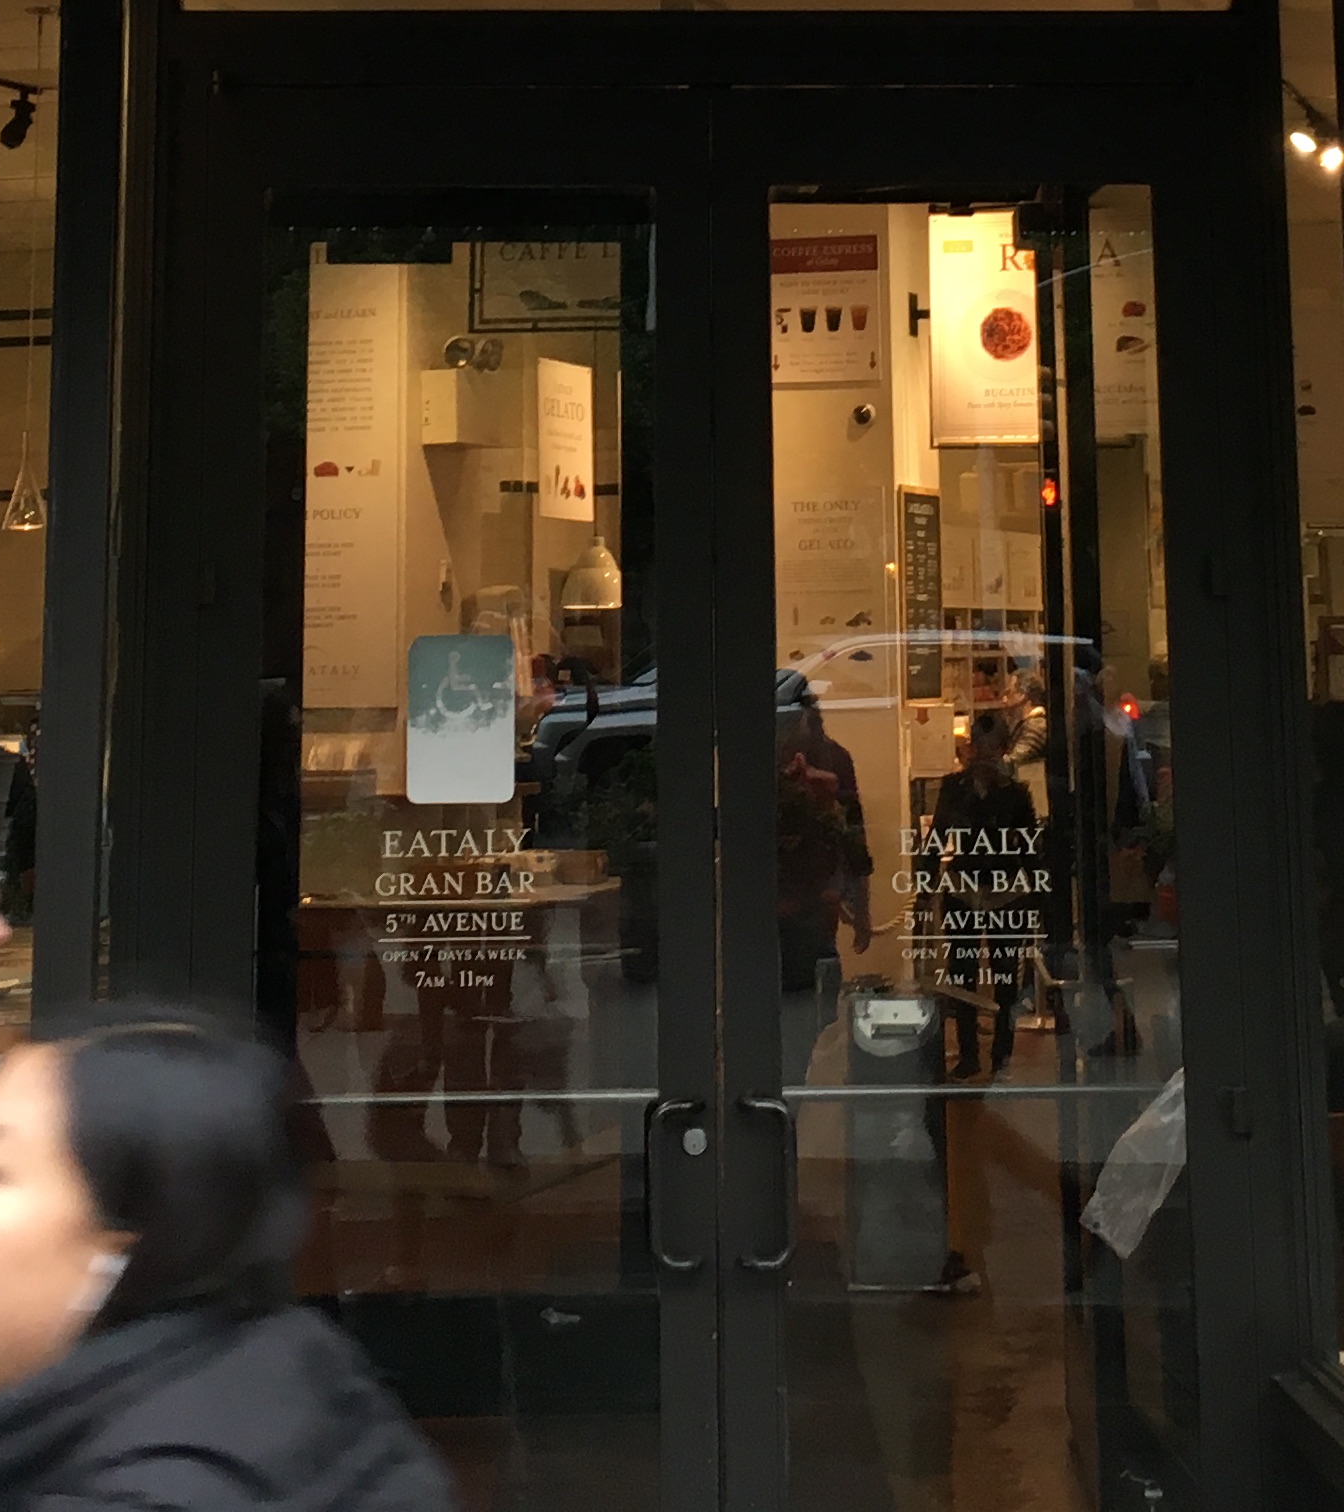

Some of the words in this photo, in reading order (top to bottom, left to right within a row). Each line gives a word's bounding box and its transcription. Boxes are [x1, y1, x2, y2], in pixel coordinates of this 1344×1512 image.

[382, 828, 531, 858] EATALY
[899, 827, 1045, 856] EATALY
[375, 871, 465, 896] GRAN
[475, 871, 536, 895] BAR
[891, 870, 981, 894] GRAN
[990, 869, 1053, 893] BAR
[385, 913, 416, 933] 5TH
[422, 911, 525, 932] AVENUE
[904, 911, 934, 930] 5TH
[940, 909, 1041, 930] AVENUE
[382, 950, 419, 962] OPEN
[423, 945, 434, 962] 7
[437, 949, 472, 961] DAYS
[474, 950, 486, 961] A
[488, 948, 527, 961] WEEK
[901, 947, 938, 960] OPEN
[941, 942, 952, 960] 7
[956, 947, 990, 959] DAYS
[992, 947, 1003, 959] A
[1004, 946, 1044, 959] WEEK
[415, 971, 445, 988] 7AM
[459, 970, 495, 987] 11PM
[934, 969, 965, 986] 7AM
[978, 968, 1013, 986] 11PM
